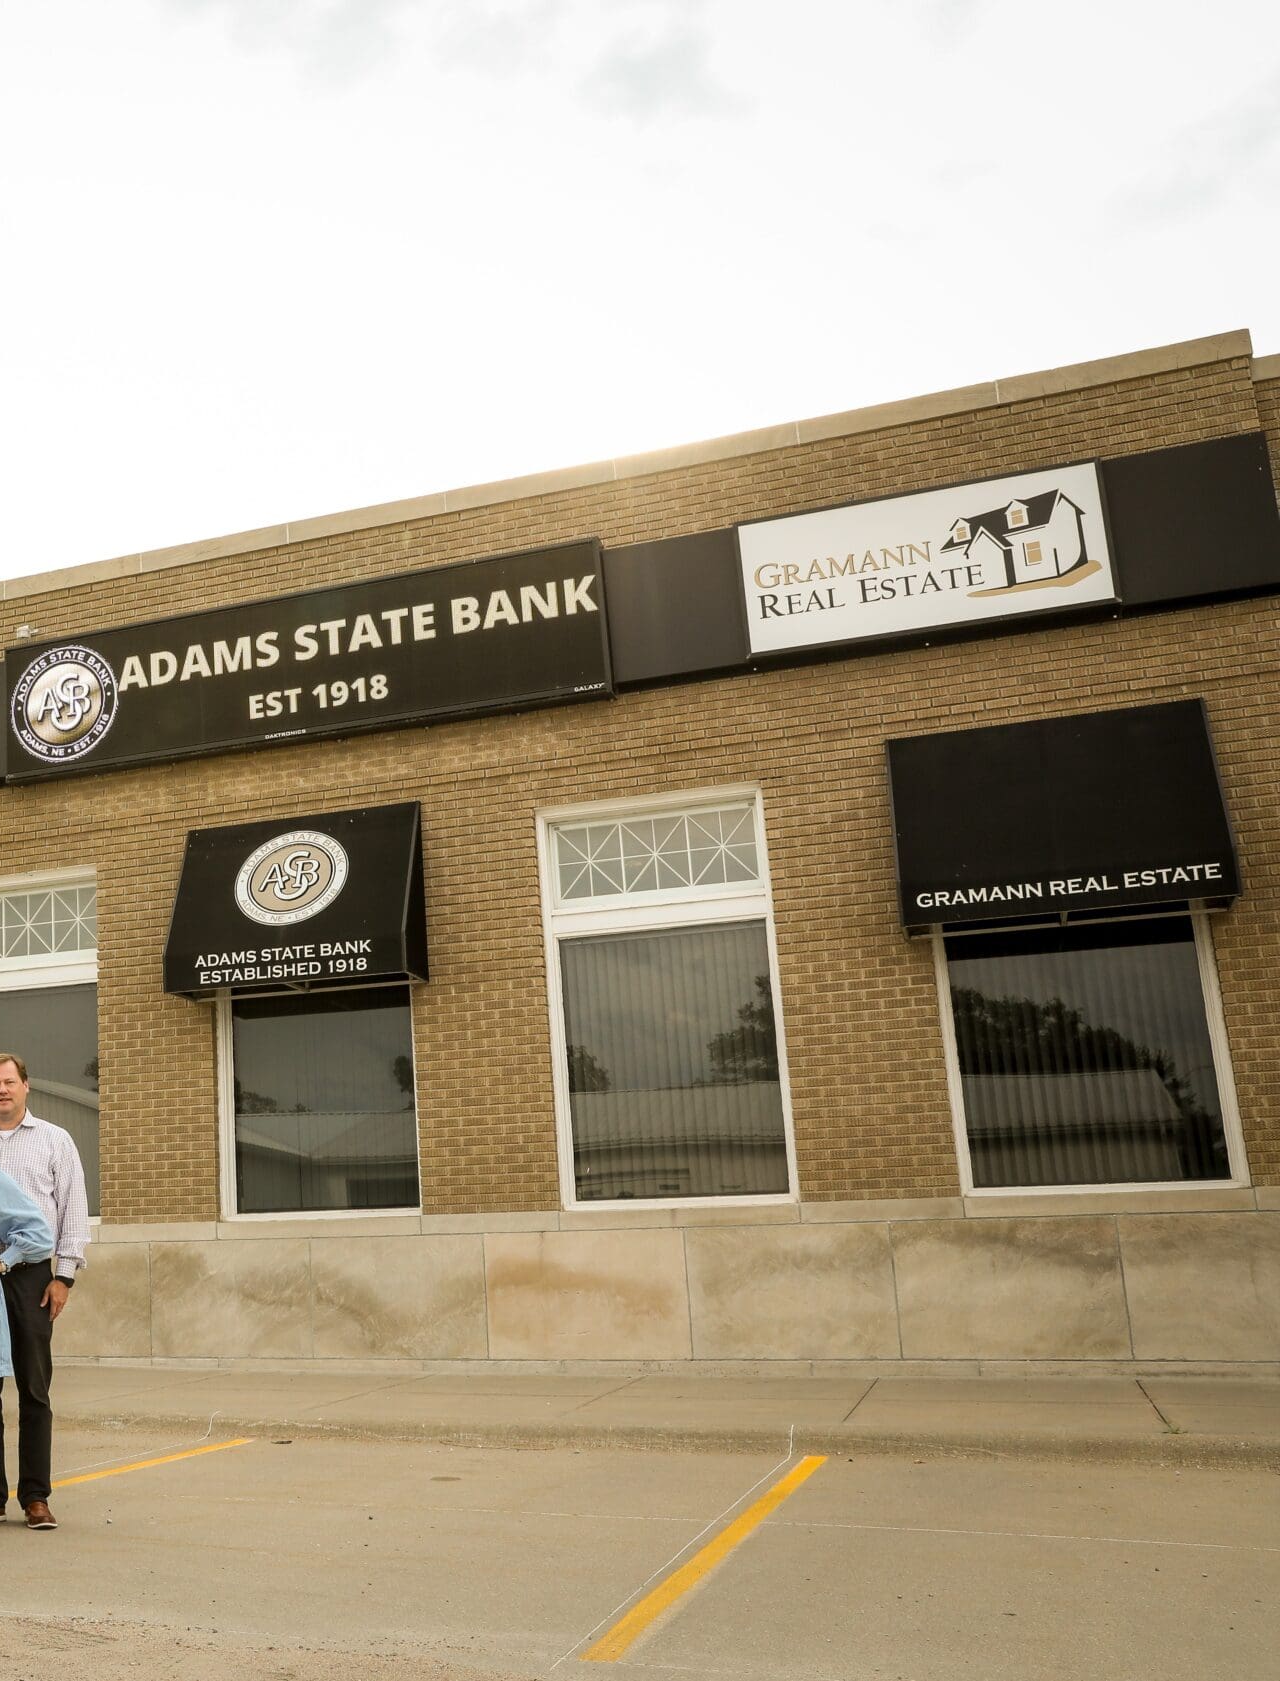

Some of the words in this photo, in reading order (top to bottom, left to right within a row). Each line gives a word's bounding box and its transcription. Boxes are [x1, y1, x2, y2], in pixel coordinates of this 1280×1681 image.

[754, 541, 932, 589] GRAMANN
[758, 587, 846, 619] REAL
[857, 563, 985, 604] ESTATE
[118, 631, 280, 692] ADAMS
[294, 603, 436, 661] STATE
[451, 574, 599, 635] BANK
[17, 660, 48, 702] ADAMS
[49, 650, 86, 663] STATE
[87, 656, 112, 688] BANK
[248, 687, 302, 720] EST
[312, 674, 389, 709] 1918
[574, 682, 606, 693] GALAXY
[51, 748, 65, 756] NE
[265, 728, 306, 740] DAKTRONICS
[243, 842, 279, 874] ADAMS
[281, 834, 320, 842] STATE
[323, 839, 345, 865] BANK
[916, 882, 1043, 908] GRAMANN
[1049, 875, 1119, 897] REAL
[1123, 863, 1222, 888] ESTATE
[194, 950, 257, 968] ADAMS
[260, 944, 316, 962] STATE
[319, 939, 373, 957] BANK
[199, 961, 322, 985] ESTABLISHED
[328, 957, 368, 974] 1918
